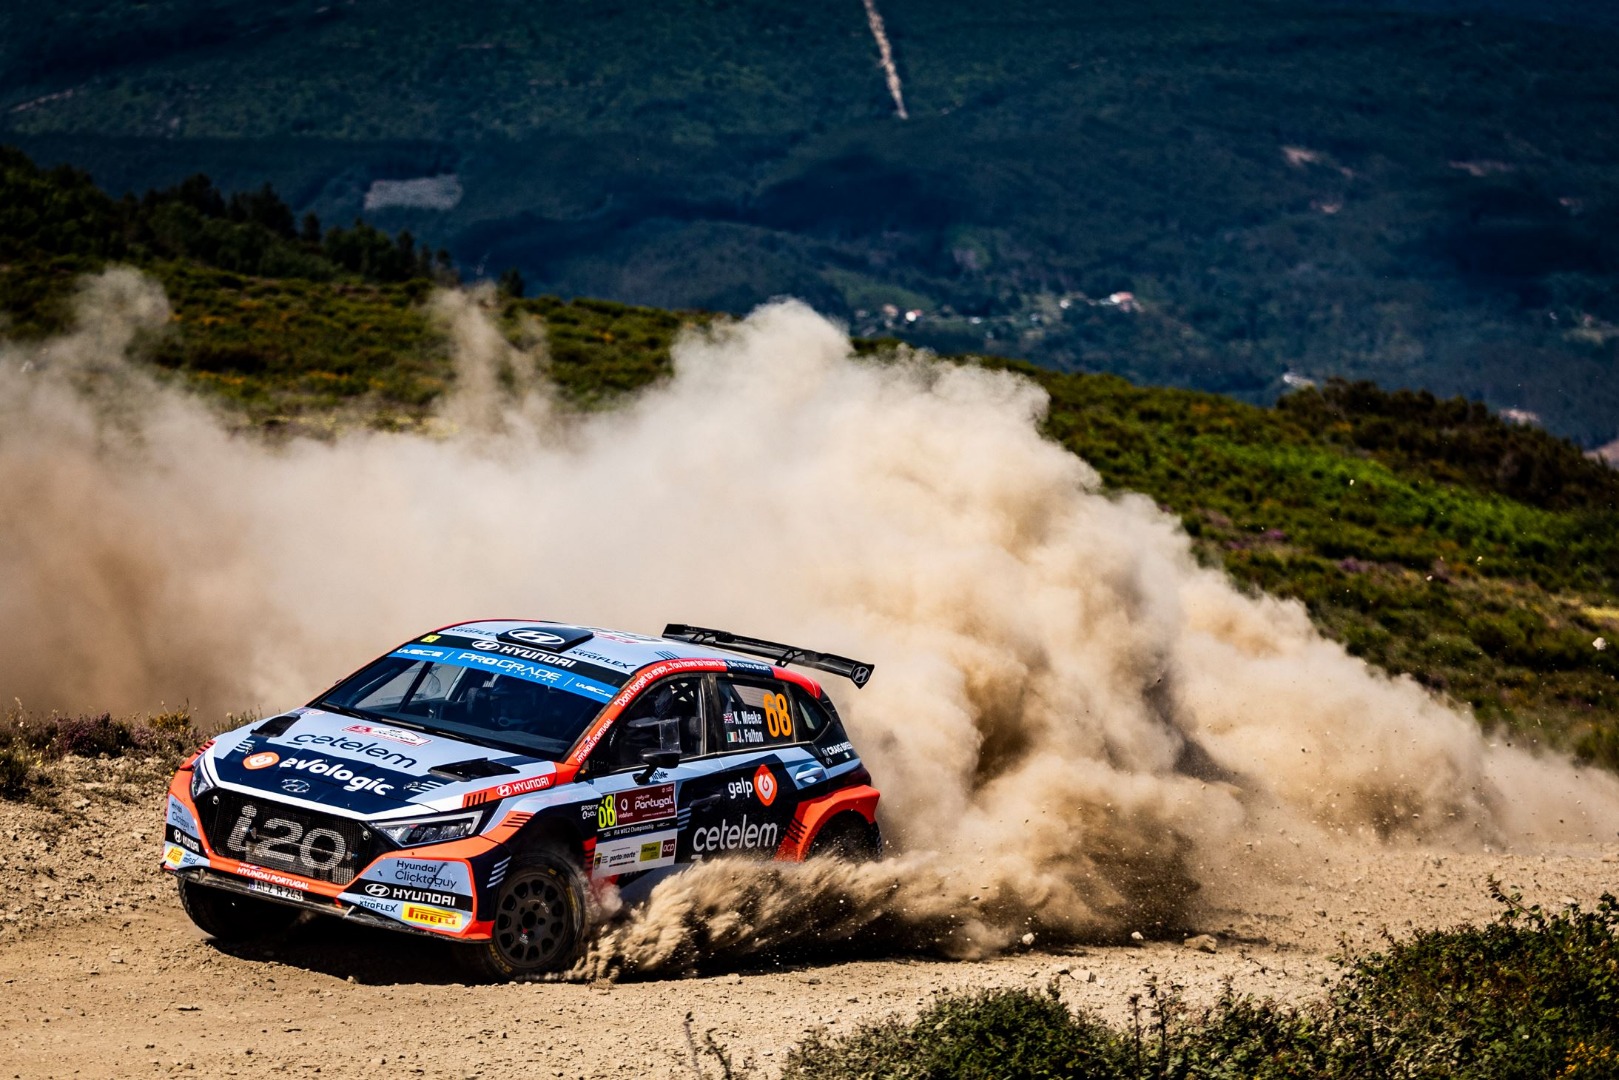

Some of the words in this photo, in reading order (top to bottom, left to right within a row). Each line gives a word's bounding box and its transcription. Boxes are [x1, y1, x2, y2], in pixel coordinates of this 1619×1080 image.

[500, 645, 577, 668] HYUNDAI
[569, 650, 636, 669] xtraFLEX
[733, 711, 741, 724] K.
[741, 711, 762, 725] Meeke
[763, 693, 792, 738] 68
[577, 740, 594, 763] HYUNDAI
[592, 718, 613, 744] PORTUGAL
[738, 729, 745, 743] J.
[744, 729, 764, 743] Fulton
[293, 734, 417, 769] cetelem
[279, 757, 395, 796] evologic
[513, 777, 549, 792] HYUNDAI
[728, 777, 753, 799] galp
[634, 795, 673, 810] Portugal
[227, 804, 346, 871] i20
[693, 814, 778, 851] cetelem
[396, 860, 437, 873] Hyundai
[237, 867, 271, 881] HYUNDAI
[271, 875, 310, 890] PORTUGAL
[359, 900, 398, 913] xtraFLEX
[392, 888, 456, 906] HYUNDAI
[408, 907, 457, 925] PIRELLI
